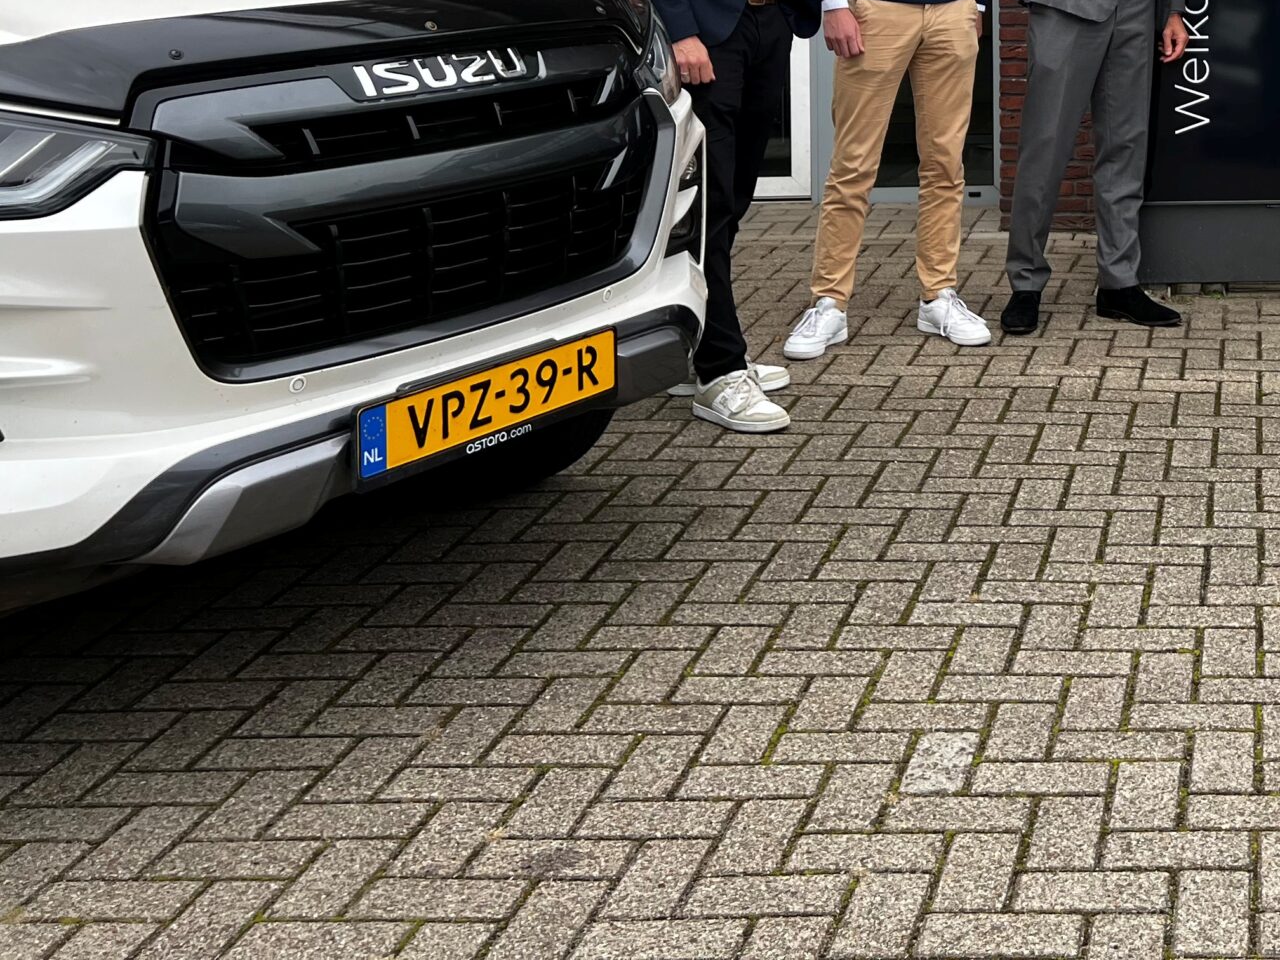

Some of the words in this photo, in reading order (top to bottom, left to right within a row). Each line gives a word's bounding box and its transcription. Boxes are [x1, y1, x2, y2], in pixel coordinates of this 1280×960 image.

[353, 47, 527, 97] ISUZU
[408, 345, 599, 449] VPZ-39-R
[363, 447, 383, 465] NL
[466, 422, 532, 454] astara.com
